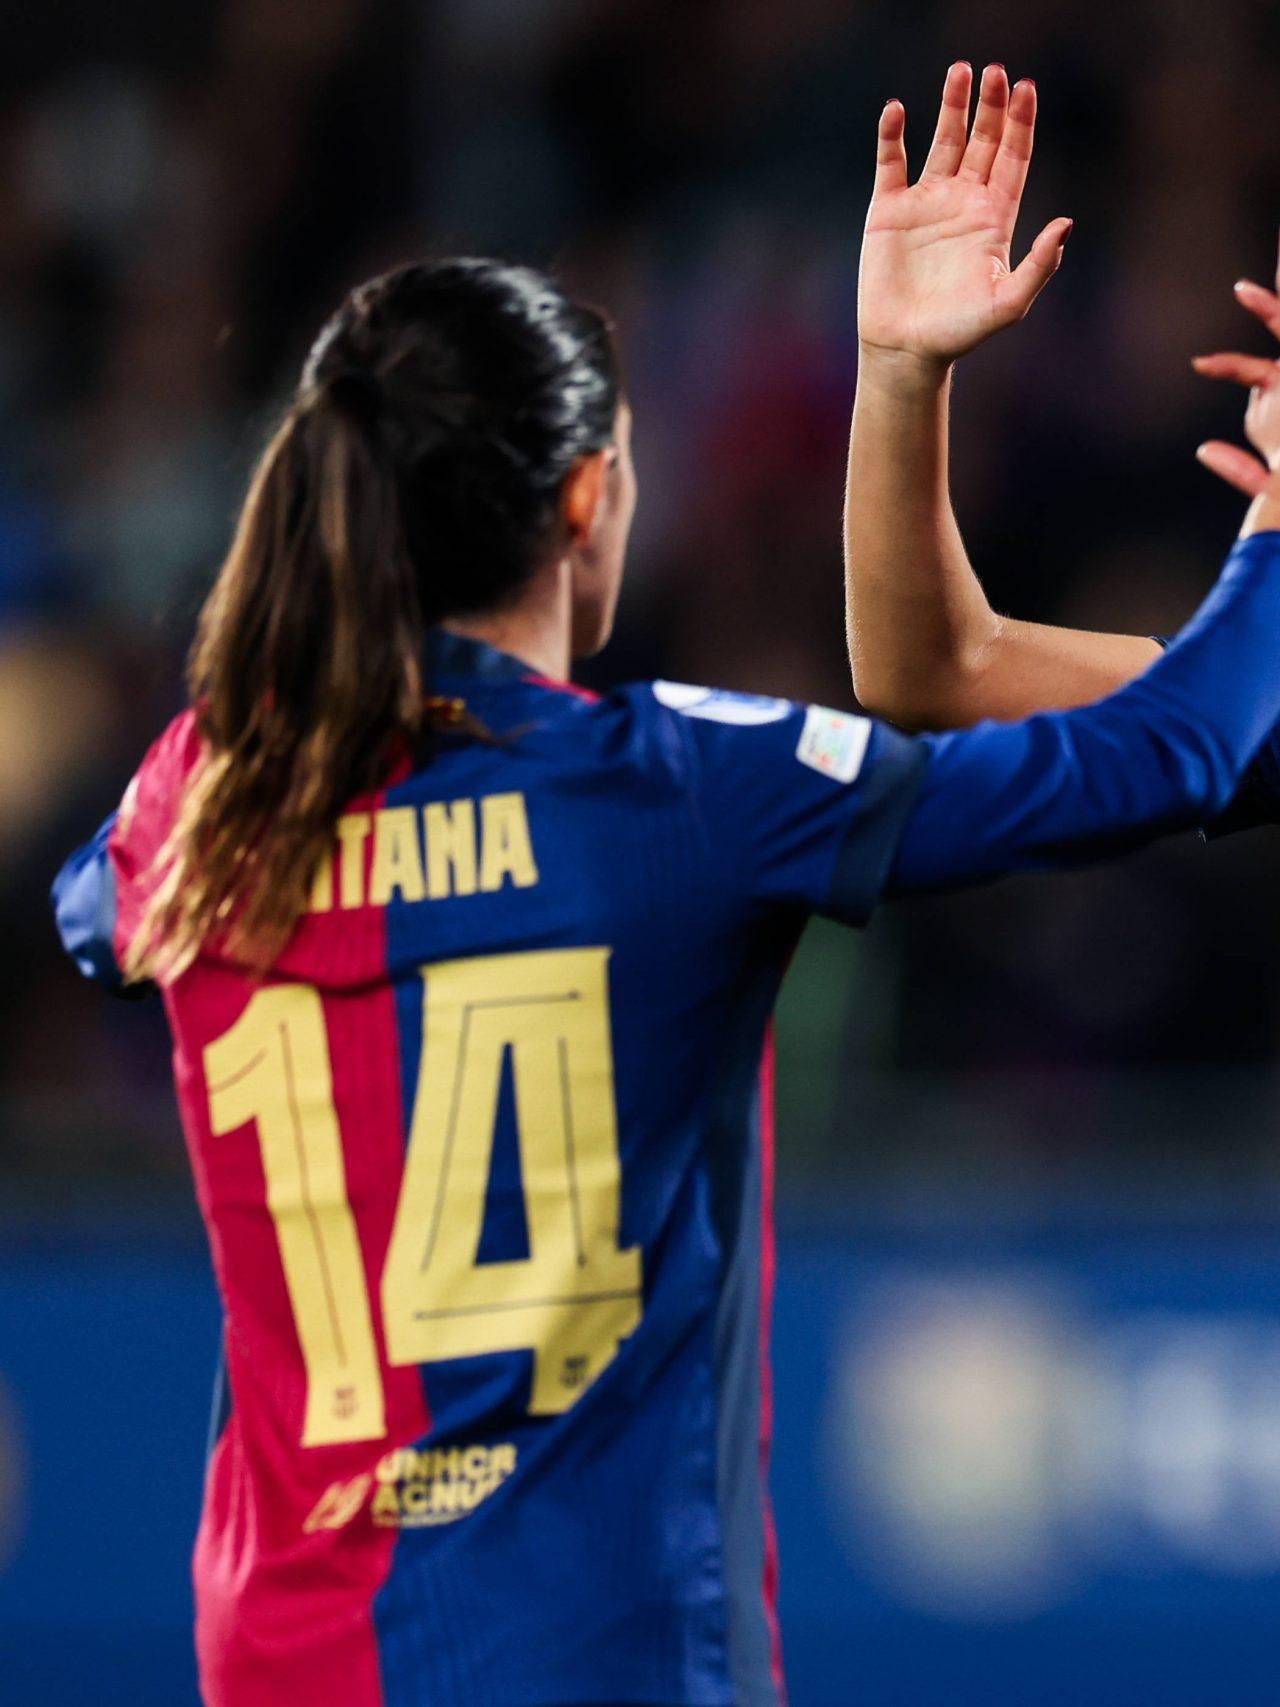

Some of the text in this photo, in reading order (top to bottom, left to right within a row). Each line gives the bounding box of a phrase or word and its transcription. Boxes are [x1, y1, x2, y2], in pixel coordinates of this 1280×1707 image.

[311, 793, 539, 912] TANA
[203, 946, 644, 1448] 14
[375, 1443, 517, 1482] UNHCR
